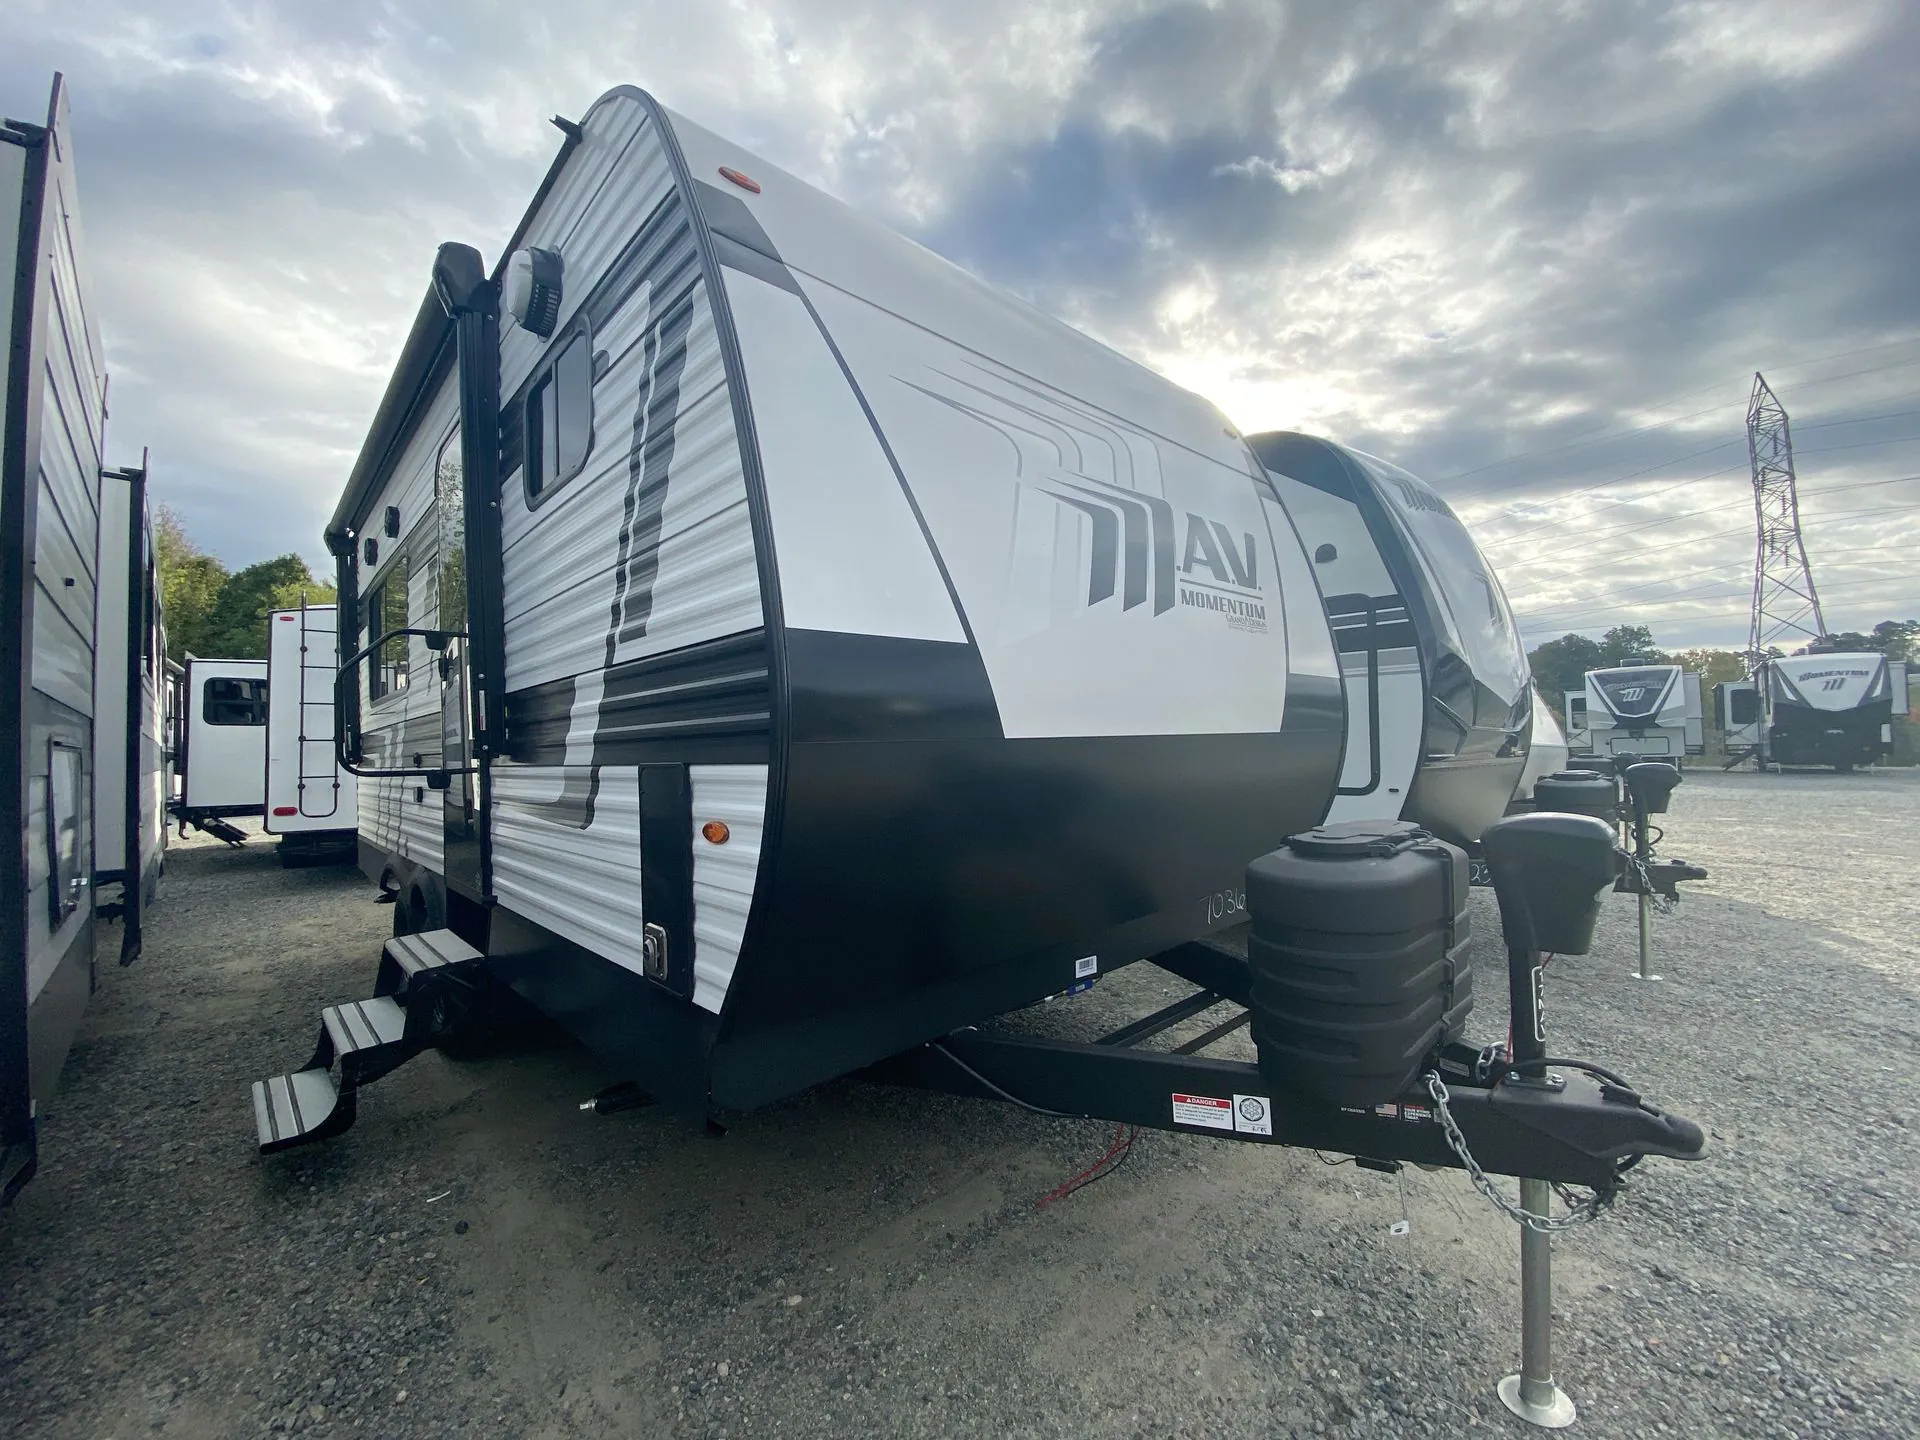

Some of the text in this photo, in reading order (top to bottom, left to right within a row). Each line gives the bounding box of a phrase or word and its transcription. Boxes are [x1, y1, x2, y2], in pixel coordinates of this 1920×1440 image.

[1180, 588, 1266, 620] MOMENTUM
[1199, 887, 1246, 925] 7036
[1191, 1098, 1218, 1107] DANGER
